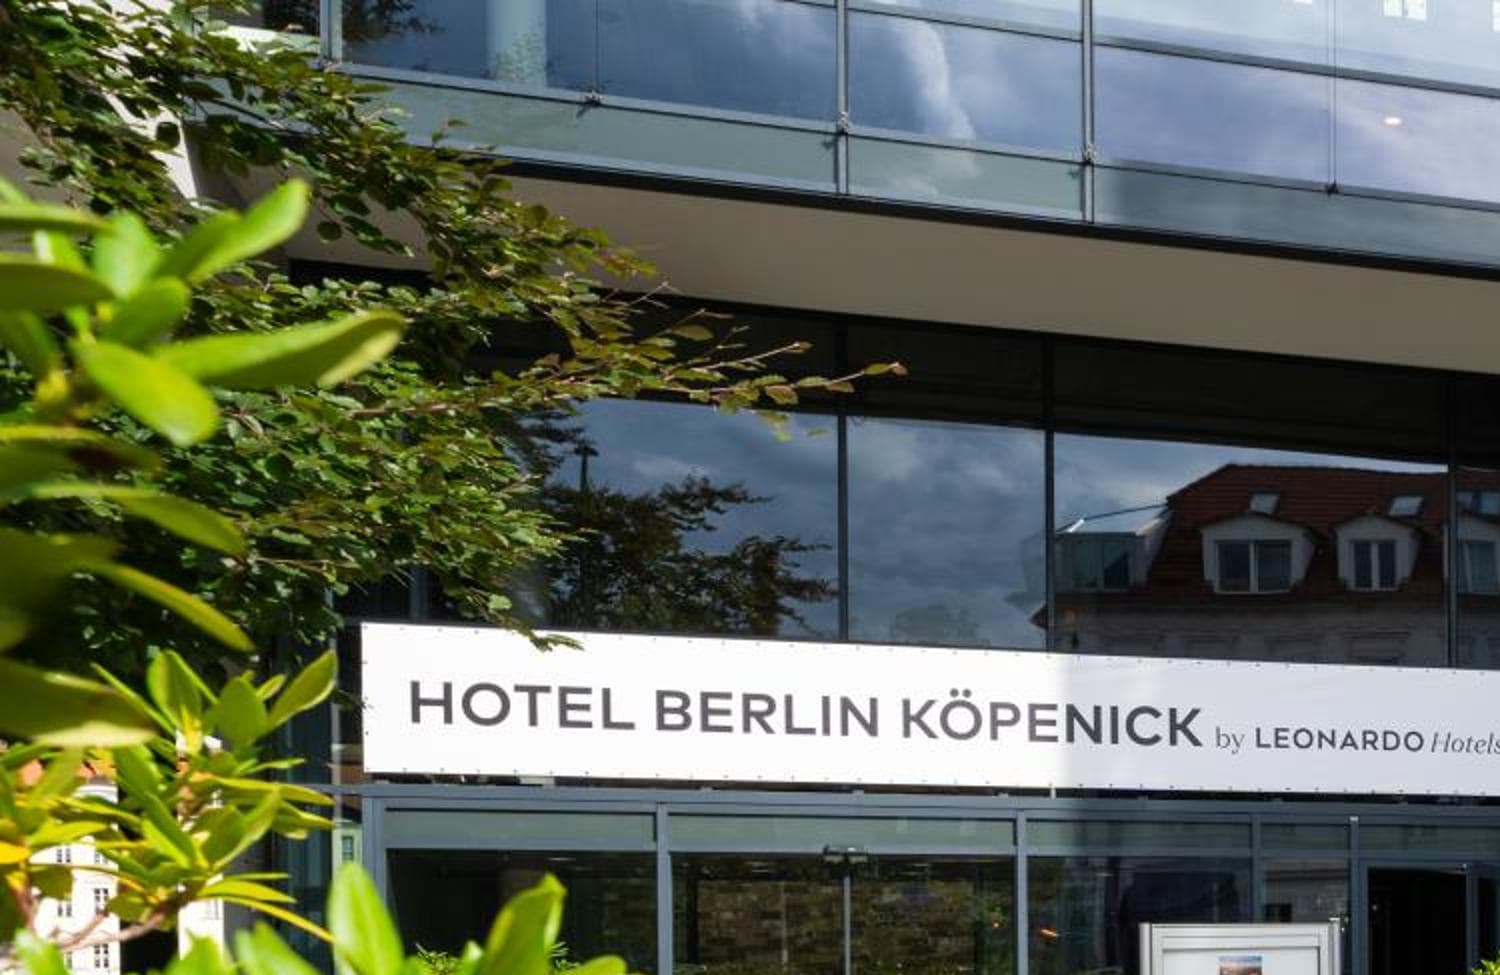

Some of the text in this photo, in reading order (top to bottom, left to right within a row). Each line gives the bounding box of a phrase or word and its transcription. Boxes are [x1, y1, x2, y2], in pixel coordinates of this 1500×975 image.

[411, 681, 635, 730] HOTEL
[656, 690, 878, 737] BERLIN
[903, 689, 1203, 748] KÖPENICK
[1215, 727, 1244, 755] by
[1255, 728, 1425, 752] LEONARDO
